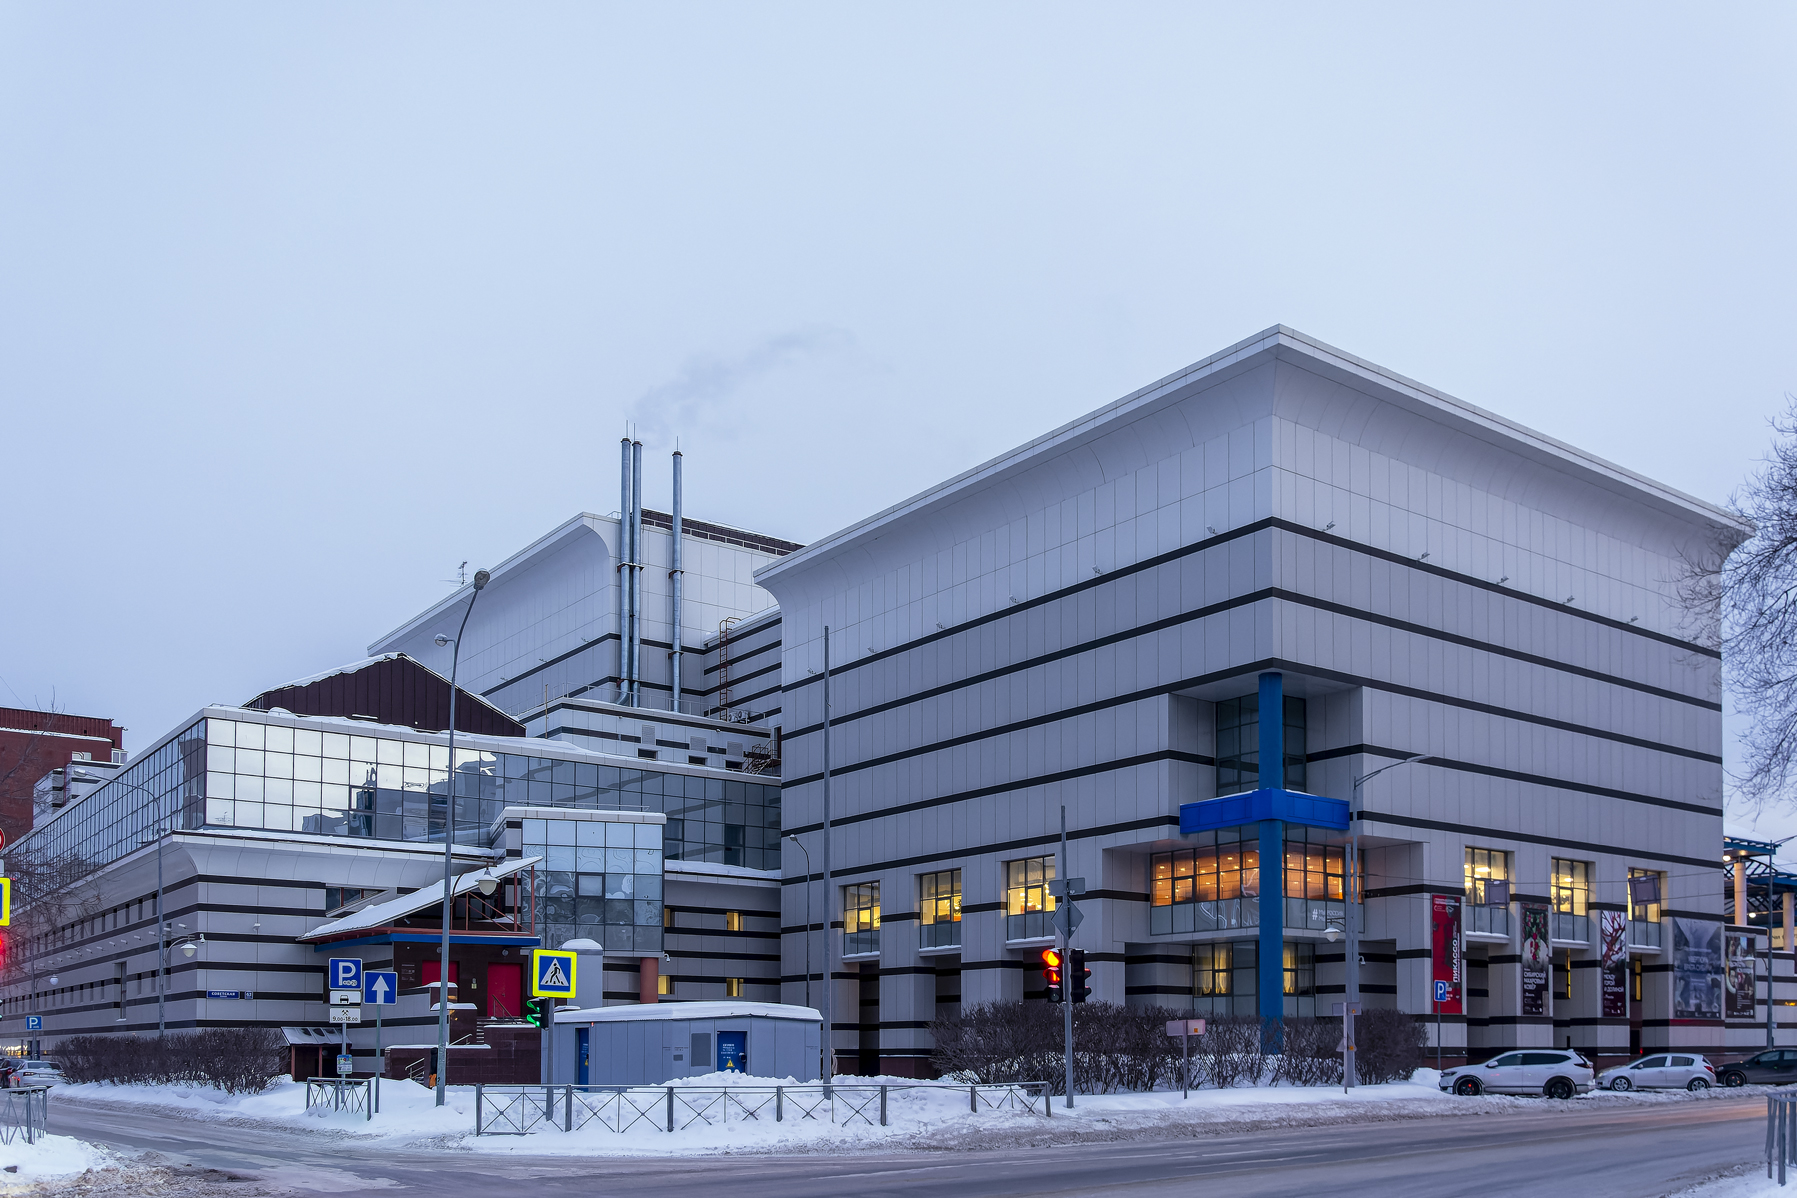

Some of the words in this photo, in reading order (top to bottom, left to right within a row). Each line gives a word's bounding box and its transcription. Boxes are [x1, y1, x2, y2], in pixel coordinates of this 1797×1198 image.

[339, 962, 356, 986] P
[1438, 983, 1444, 999] P
[30, 1018, 38, 1028] P
